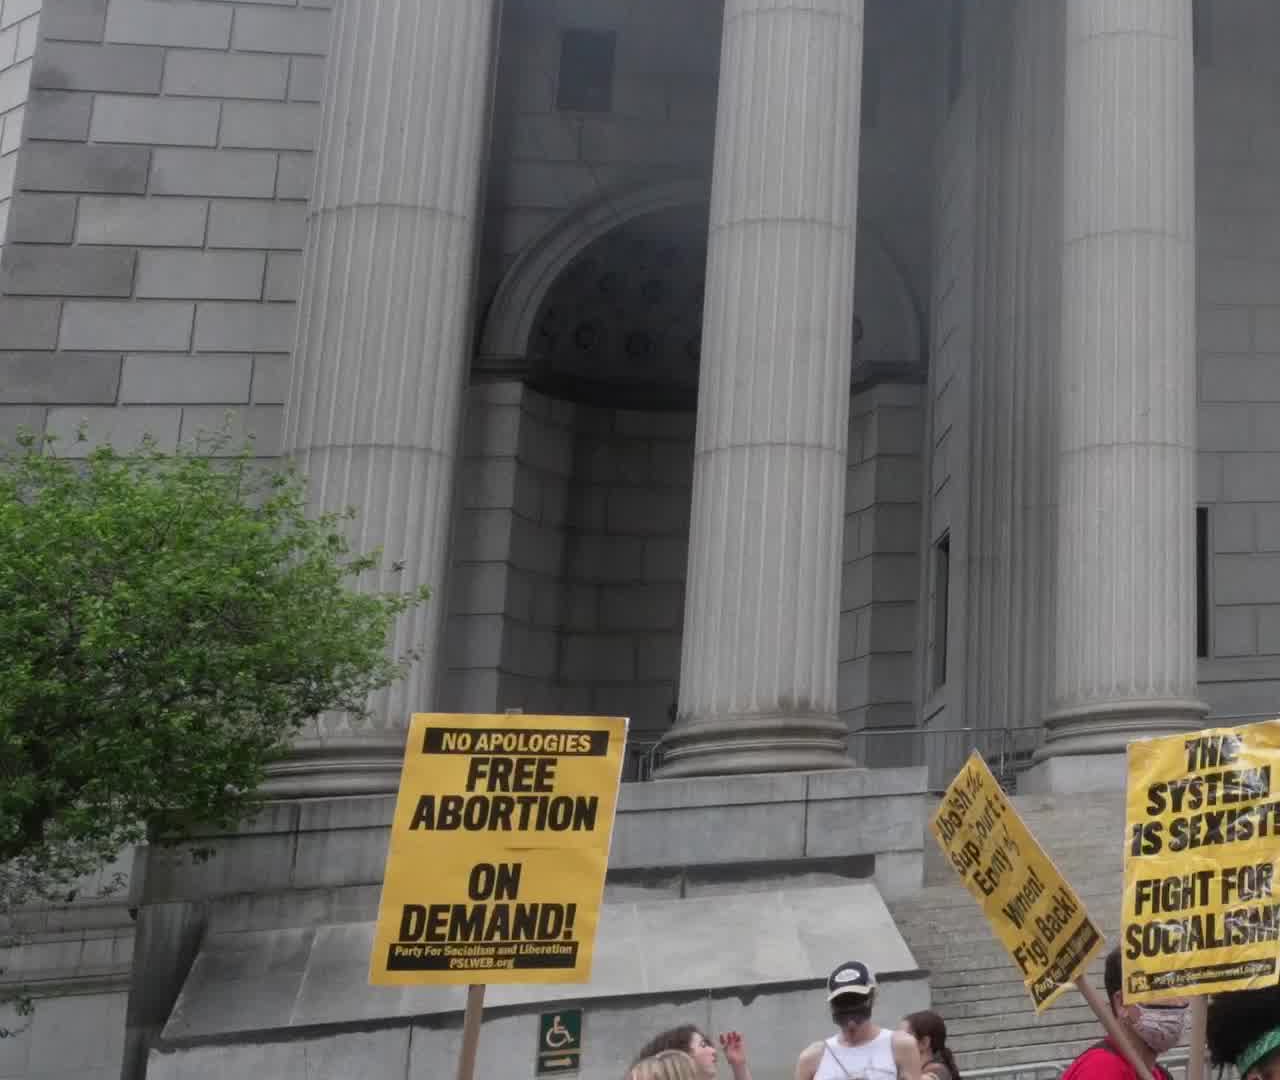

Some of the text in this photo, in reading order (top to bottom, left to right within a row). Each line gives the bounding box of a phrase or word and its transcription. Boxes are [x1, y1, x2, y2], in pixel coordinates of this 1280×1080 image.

[441, 731, 592, 753] NO APOLOGIES
[465, 756, 558, 793] FREE
[1146, 765, 1271, 817] SYSTEM
[408, 794, 600, 832] ABORTION
[1131, 821, 1164, 857] IS
[468, 862, 522, 902] ON
[1002, 865, 1045, 930] Wmen!
[1134, 863, 1274, 916] FIGHT FOR
[398, 903, 577, 942] DEMAND!
[1013, 942, 1050, 976] Fig
[1035, 887, 1079, 944] Back!
[394, 942, 573, 958] Party For Socialism and Liberation
